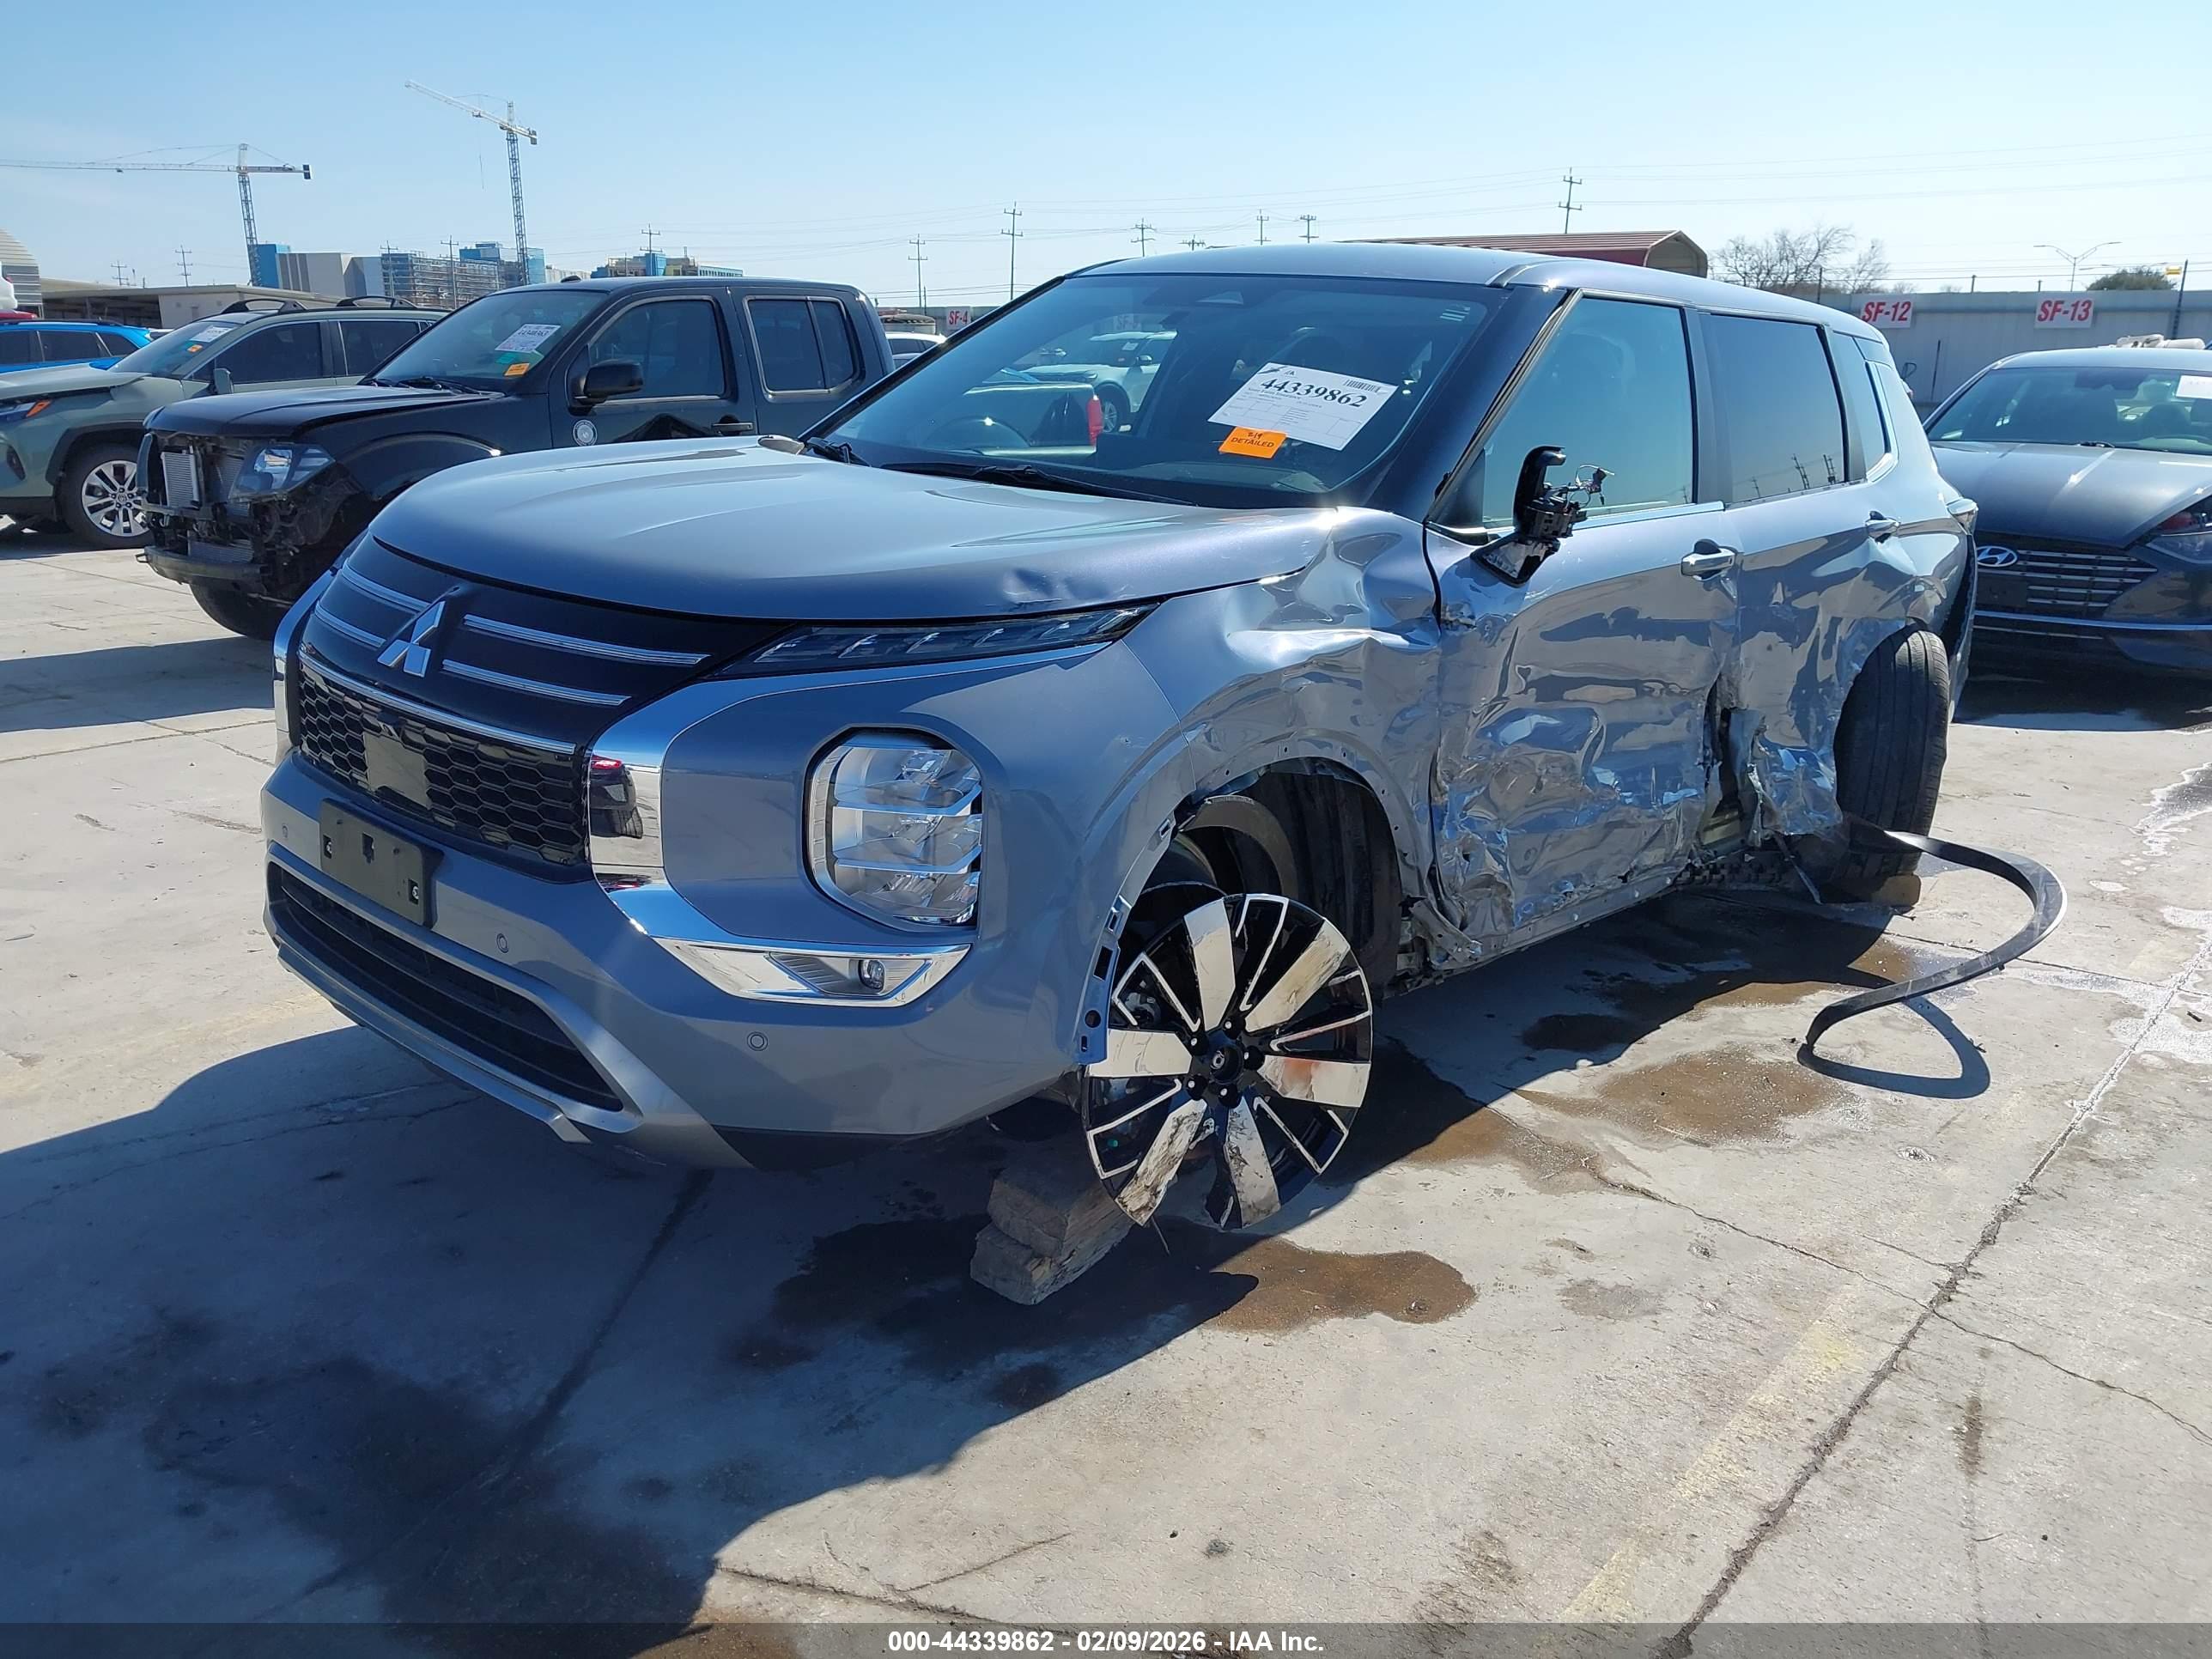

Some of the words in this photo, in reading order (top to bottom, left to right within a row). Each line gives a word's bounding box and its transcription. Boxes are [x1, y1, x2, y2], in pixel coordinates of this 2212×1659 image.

[949, 310, 968, 325] SF-4
[1861, 301, 1911, 322] SF-12
[2037, 300, 2093, 322] SF-13
[1260, 378, 1367, 408] 44339862
[1231, 437, 1274, 447] DETAILED
